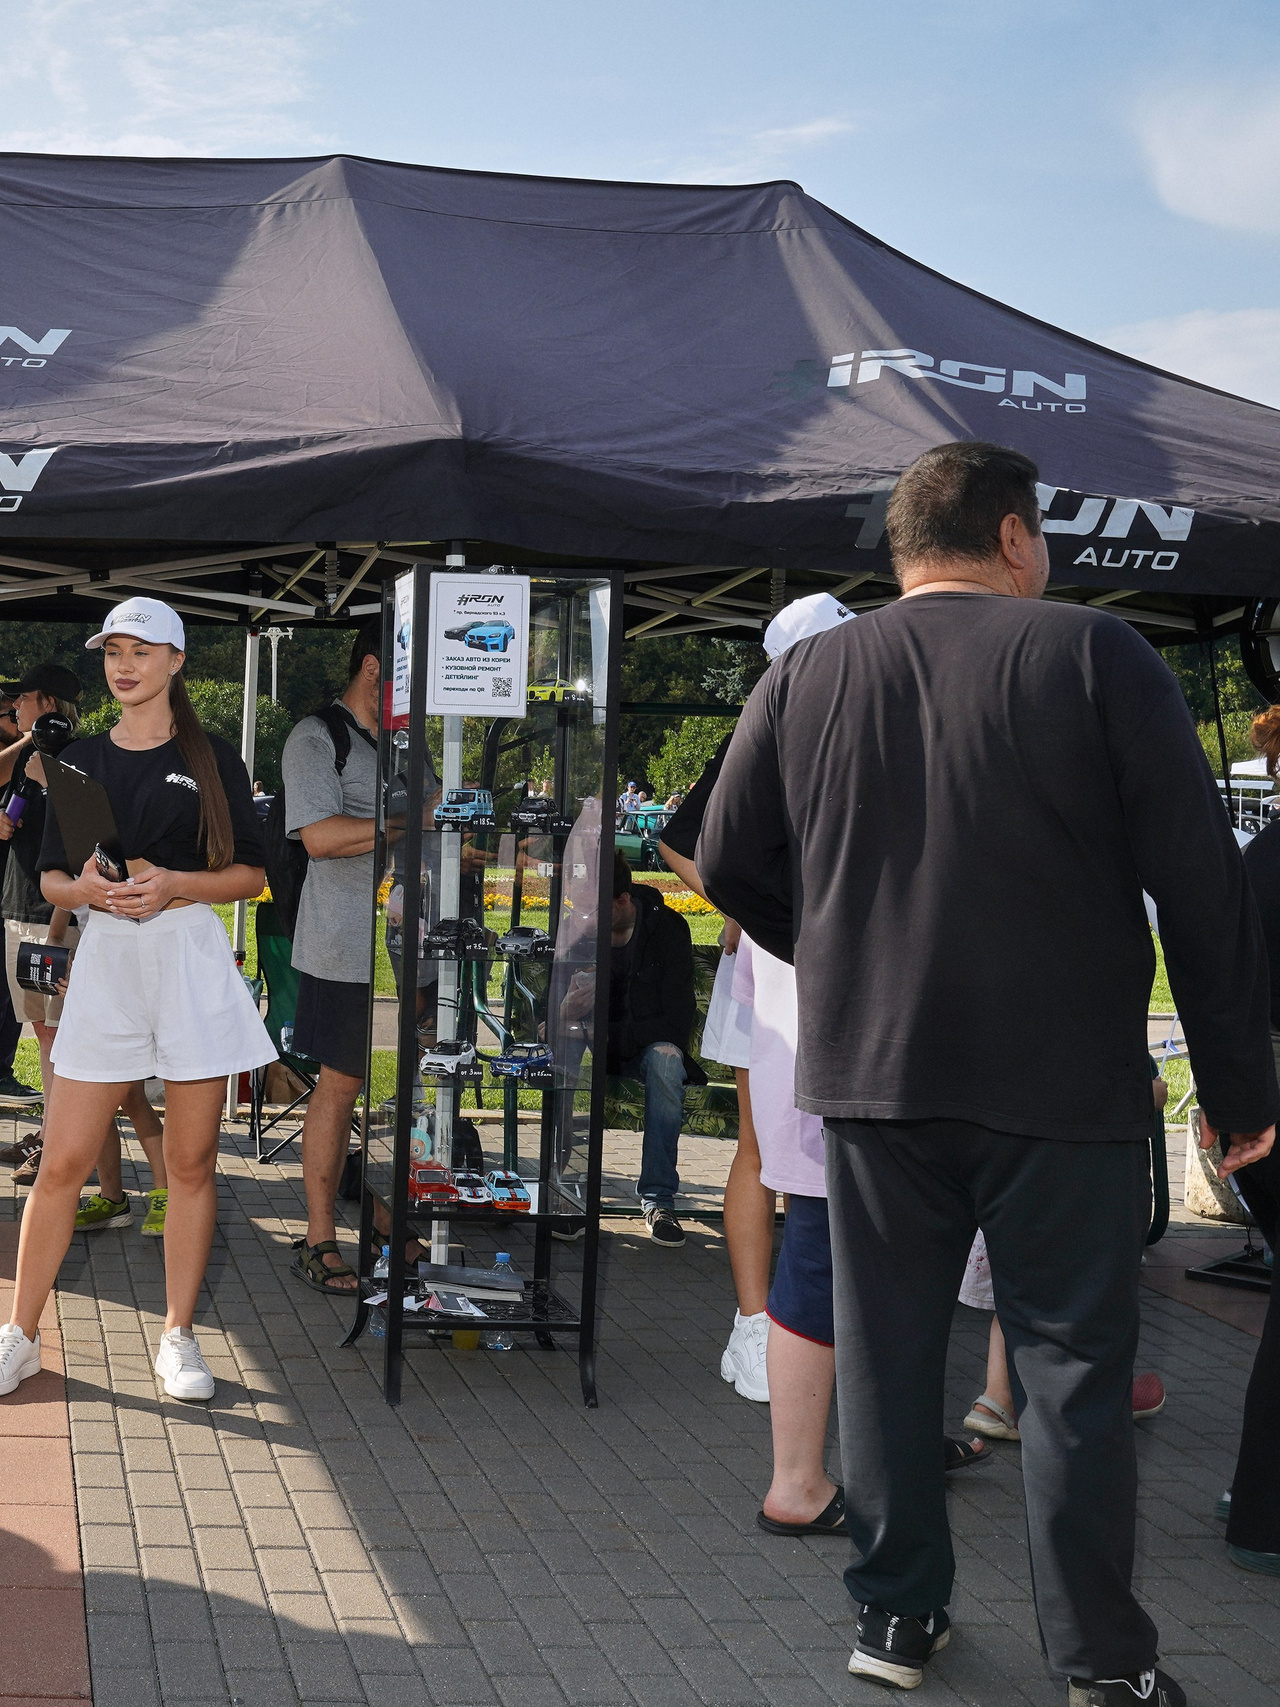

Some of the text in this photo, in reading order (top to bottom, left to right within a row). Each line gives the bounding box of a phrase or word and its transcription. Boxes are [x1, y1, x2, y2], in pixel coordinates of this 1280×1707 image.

[997, 398, 1087, 414] AUTO
[1073, 547, 1180, 571] AUTO
[468, 1068, 474, 1076] 3
